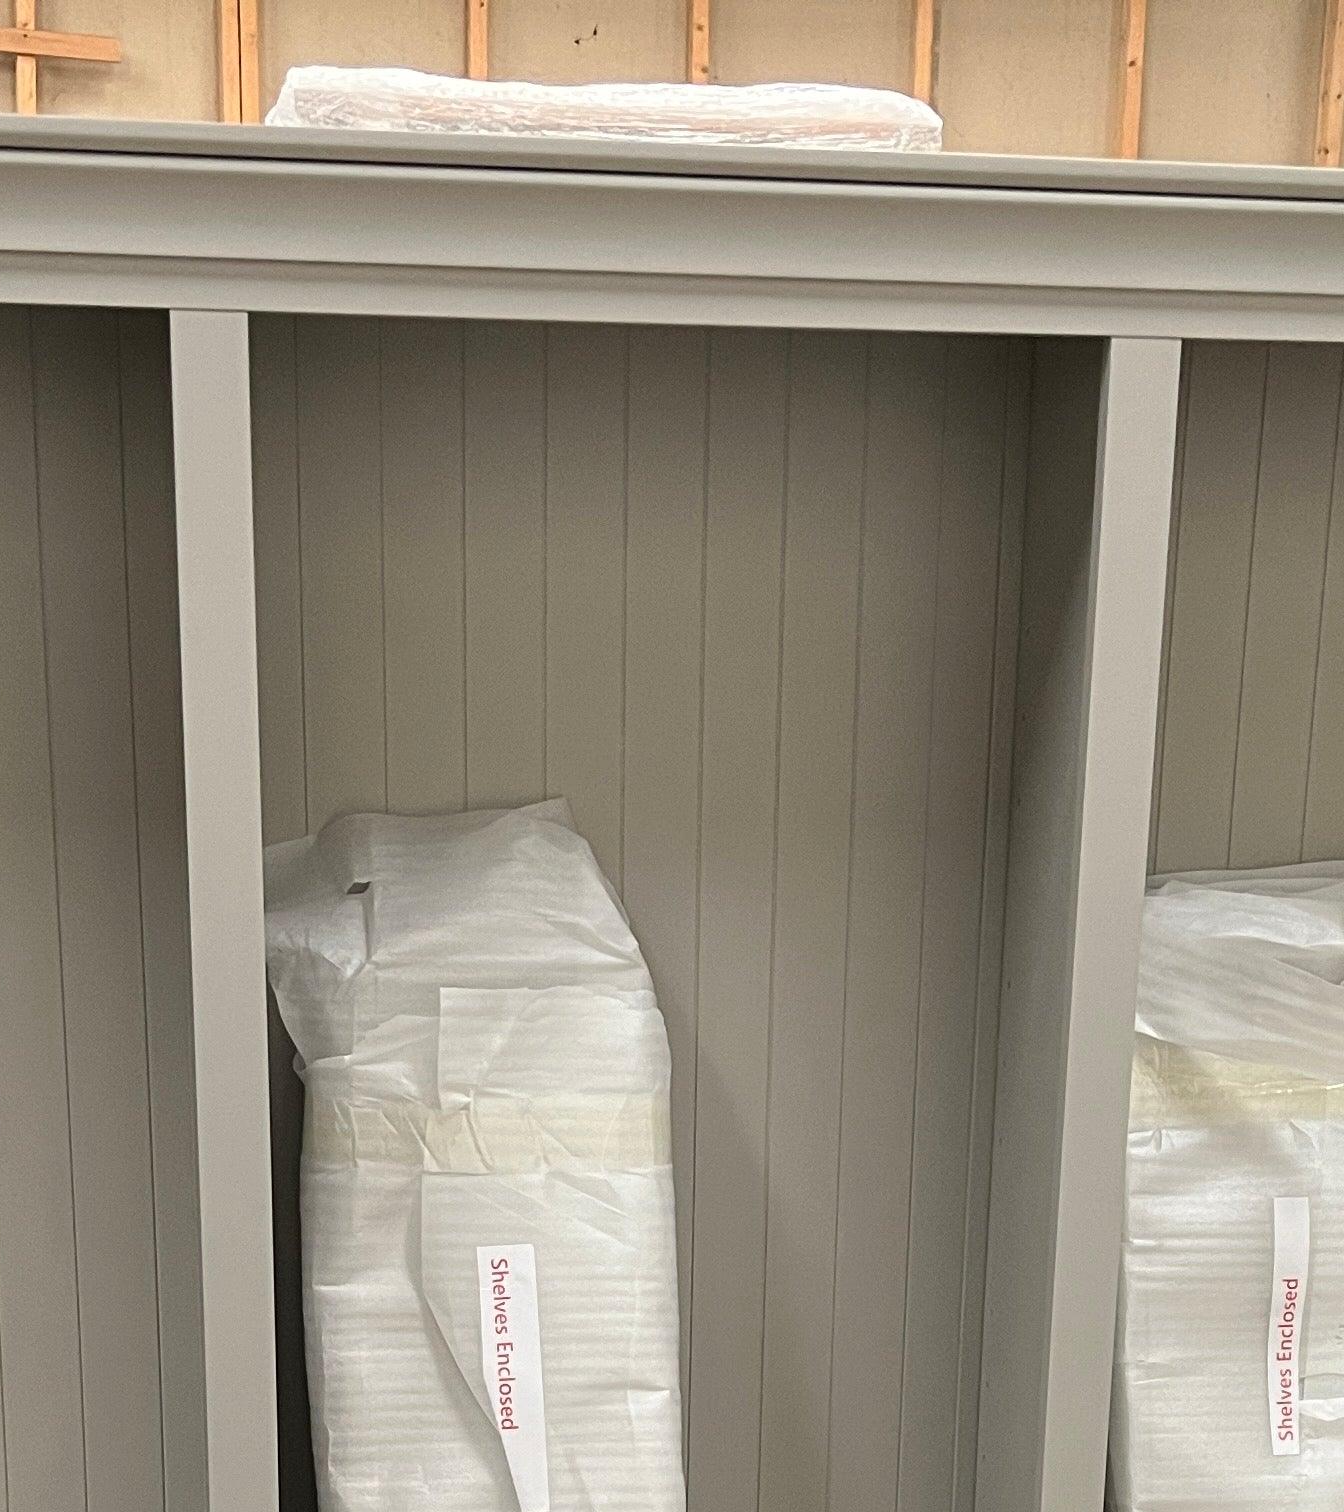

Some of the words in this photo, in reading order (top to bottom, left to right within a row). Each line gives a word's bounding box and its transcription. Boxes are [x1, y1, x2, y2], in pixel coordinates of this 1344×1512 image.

[492, 1258, 511, 1335] Shelves
[1276, 1275, 1301, 1363] Enclosed
[496, 1341, 519, 1432] Enclosed
[1276, 1368, 1294, 1442] Shelves
